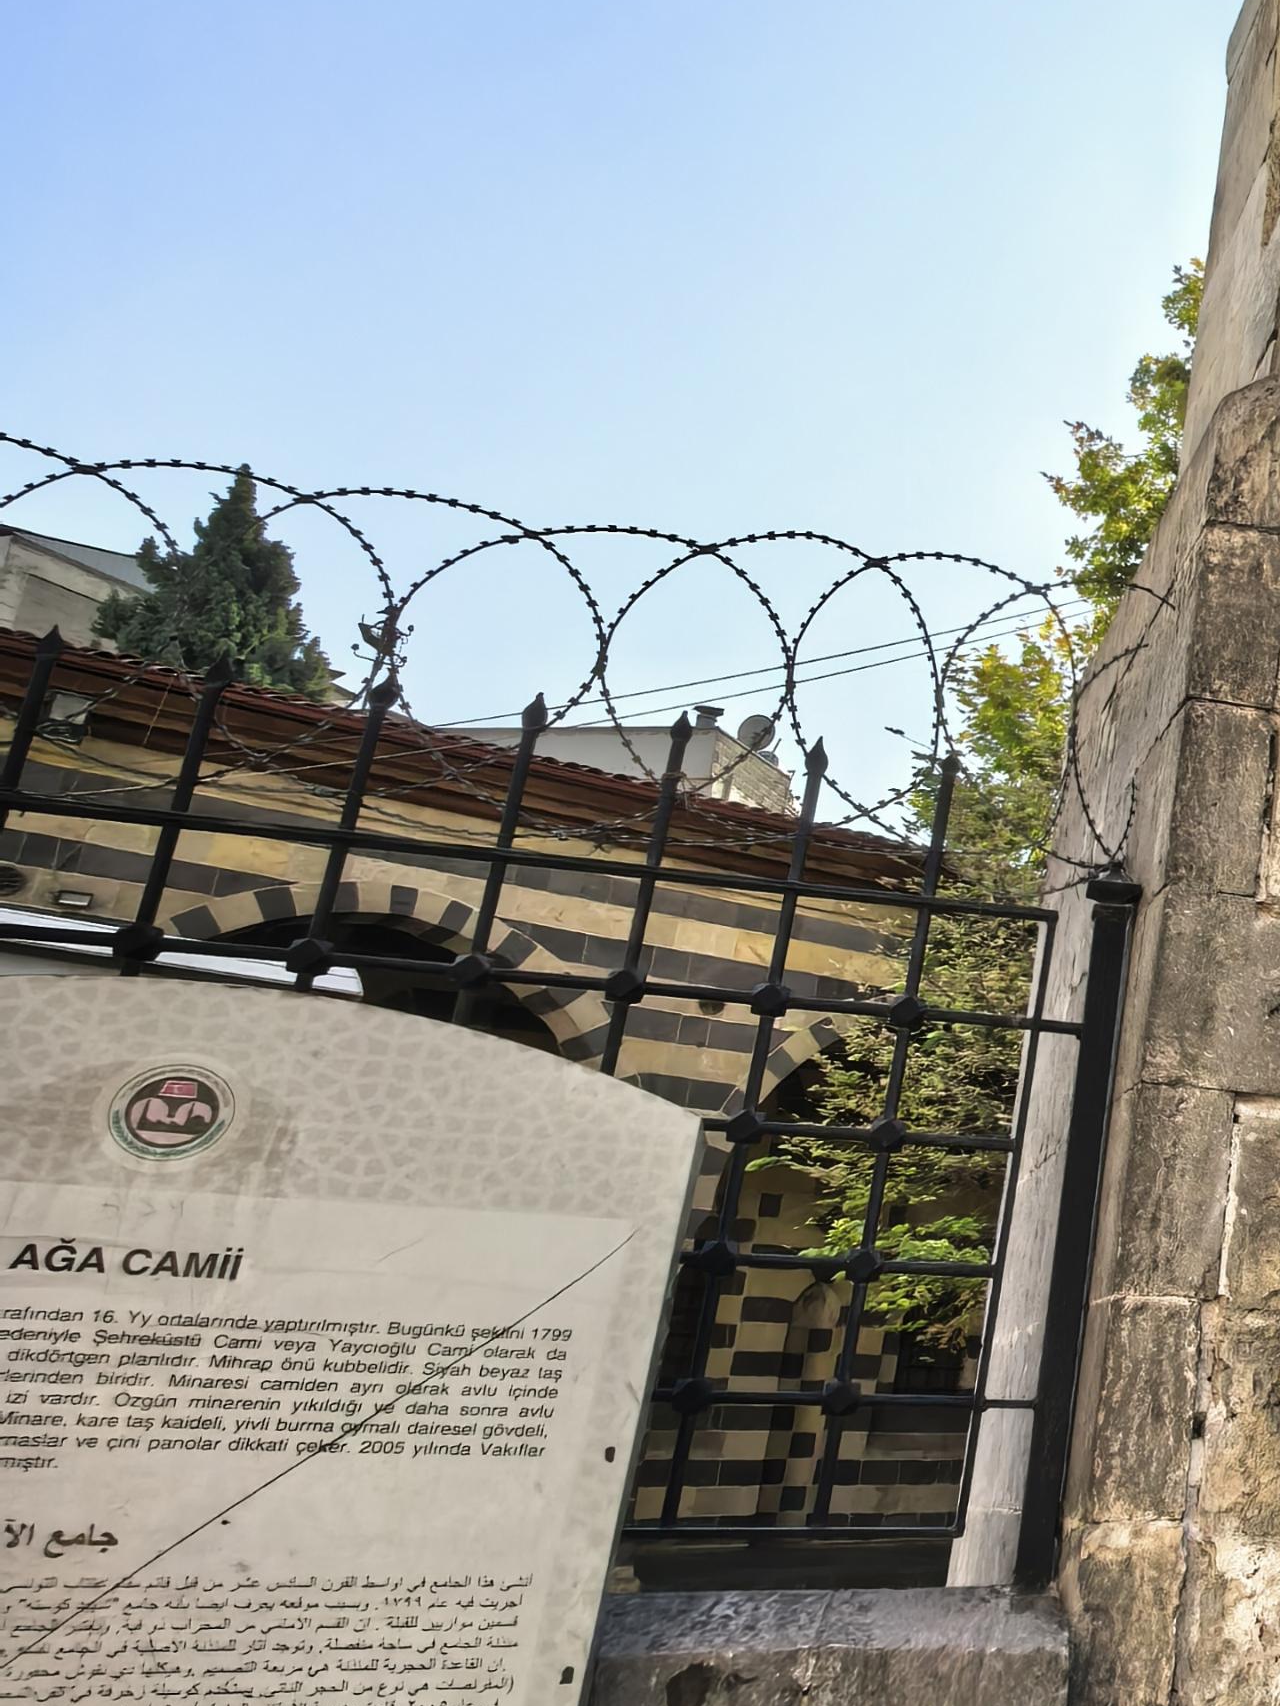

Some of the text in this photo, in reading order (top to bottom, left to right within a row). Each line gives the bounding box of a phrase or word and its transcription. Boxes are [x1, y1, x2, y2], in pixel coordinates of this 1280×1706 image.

[9, 1238, 244, 1280] AĞA CAMİİ
[0, 1306, 83, 1322] rafından
[157, 1312, 257, 1329] ortalarında
[387, 1322, 465, 1339] Bugünkü
[531, 1328, 572, 1341] 1799
[214, 1335, 262, 1350] Cami
[274, 1340, 315, 1355] veya
[427, 1343, 474, 1357] Cami
[483, 1347, 535, 1359] olarak
[547, 1349, 566, 1361] da
[8, 1349, 110, 1367] dikdörtgen
[208, 1355, 272, 1372] Mihrap
[281, 1357, 315, 1370] önü
[479, 1365, 529, 1380] beyaz
[538, 1367, 562, 1382] taş
[168, 1374, 249, 1389] Minaresi
[260, 1377, 338, 1392] camiden
[350, 1382, 383, 1396] ayrı
[395, 1383, 449, 1395] olarak
[461, 1384, 497, 1397] avlu
[508, 1386, 558, 1401] içinde
[188, 1396, 280, 1410] minarenin
[405, 1402, 449, 1415] daha
[460, 1405, 508, 1417] sonra
[519, 1405, 554, 1418] avlu
[76, 1414, 118, 1427] kare
[126, 1416, 154, 1431] taş
[234, 1417, 269, 1433] yivli
[275, 1419, 334, 1433] burma
[407, 1422, 476, 1436] dairesel
[107, 1435, 141, 1451] çini
[148, 1437, 221, 1452] panolar
[228, 1437, 288, 1452] dikkati
[358, 1441, 404, 1455] 2005
[412, 1442, 470, 1458] yılında
[43, 1524, 119, 1558] جامع
